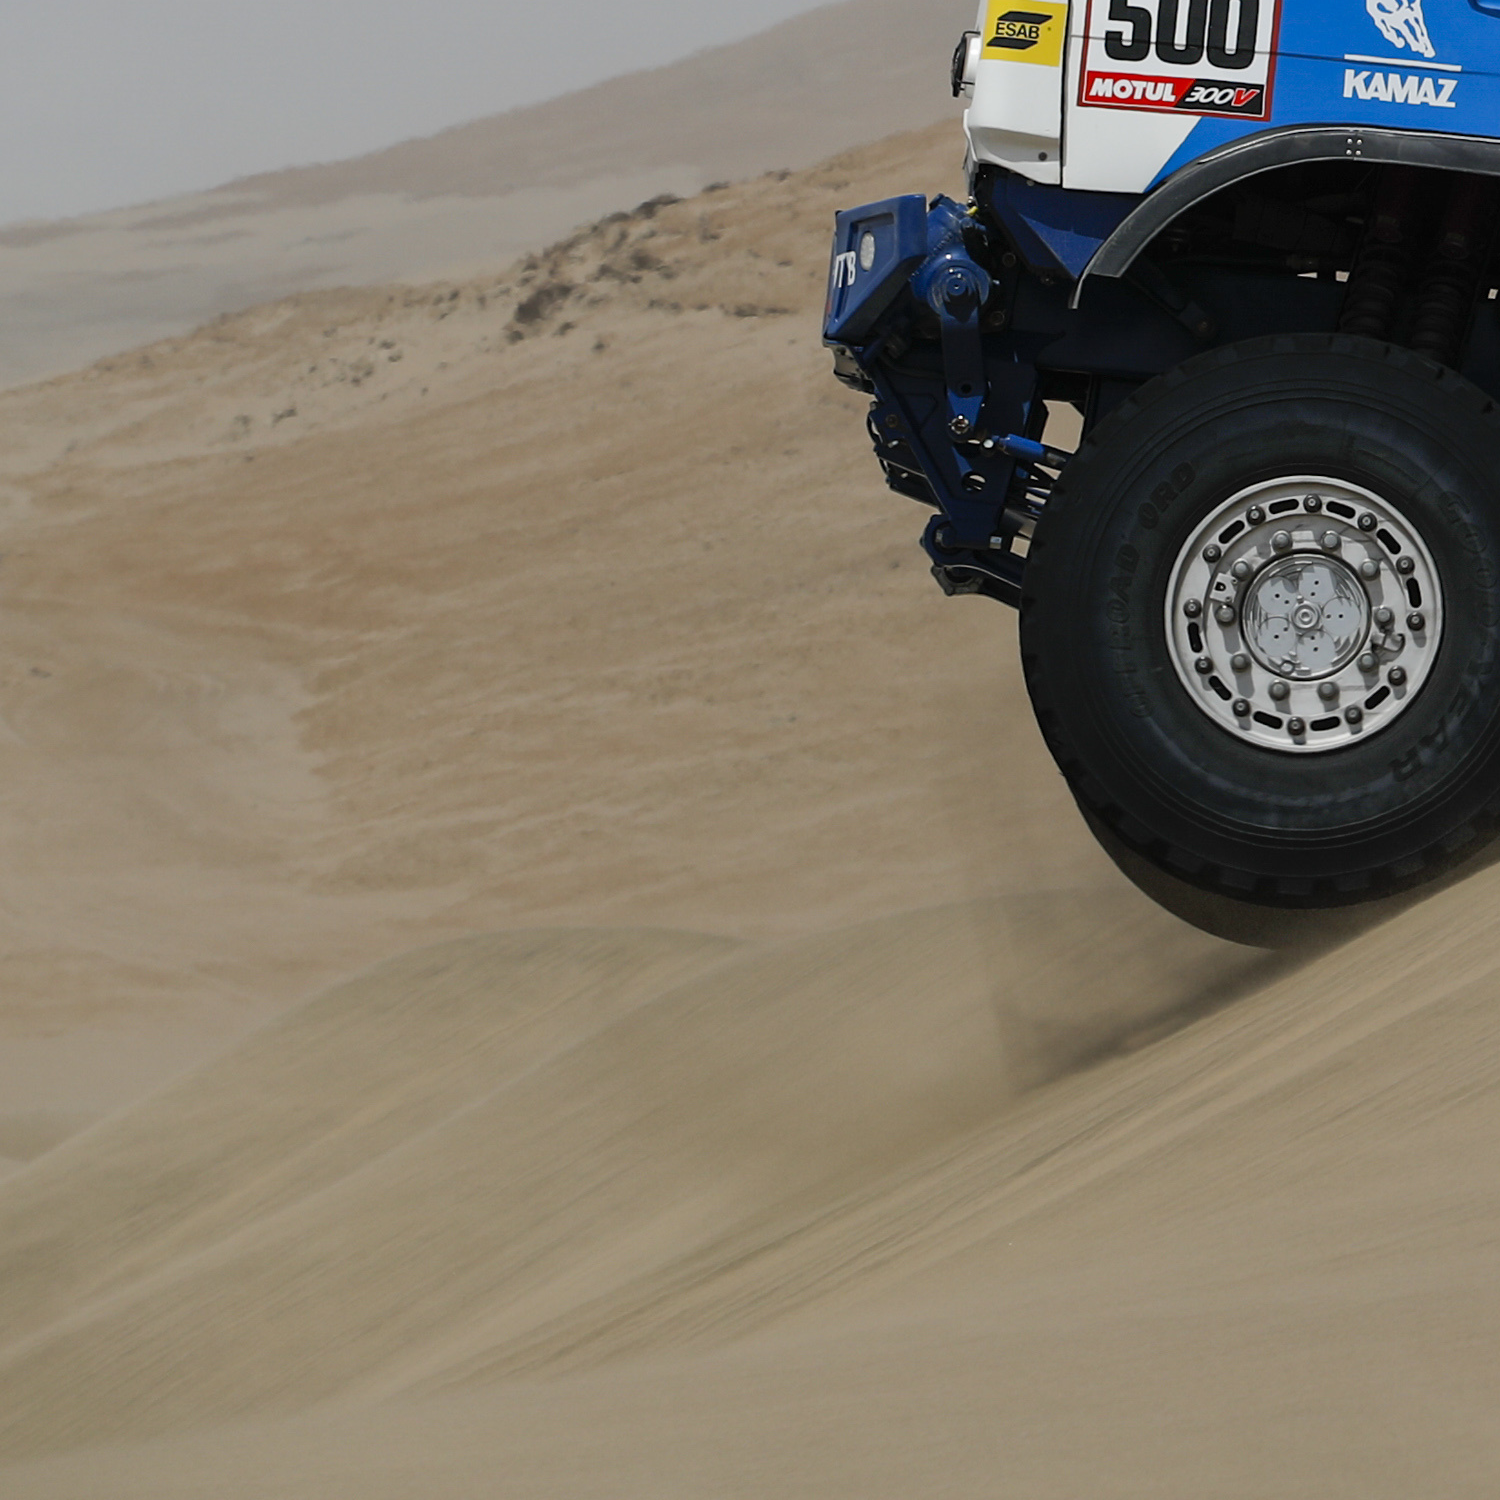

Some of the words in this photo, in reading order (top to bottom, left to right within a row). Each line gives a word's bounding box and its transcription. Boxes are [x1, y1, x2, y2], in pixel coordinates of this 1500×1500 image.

[995, 22, 1040, 40] ESAB
[1088, 77, 1177, 102] MOTUL
[1184, 86, 1260, 107] 300V
[1343, 69, 1458, 108] KAMAZ
